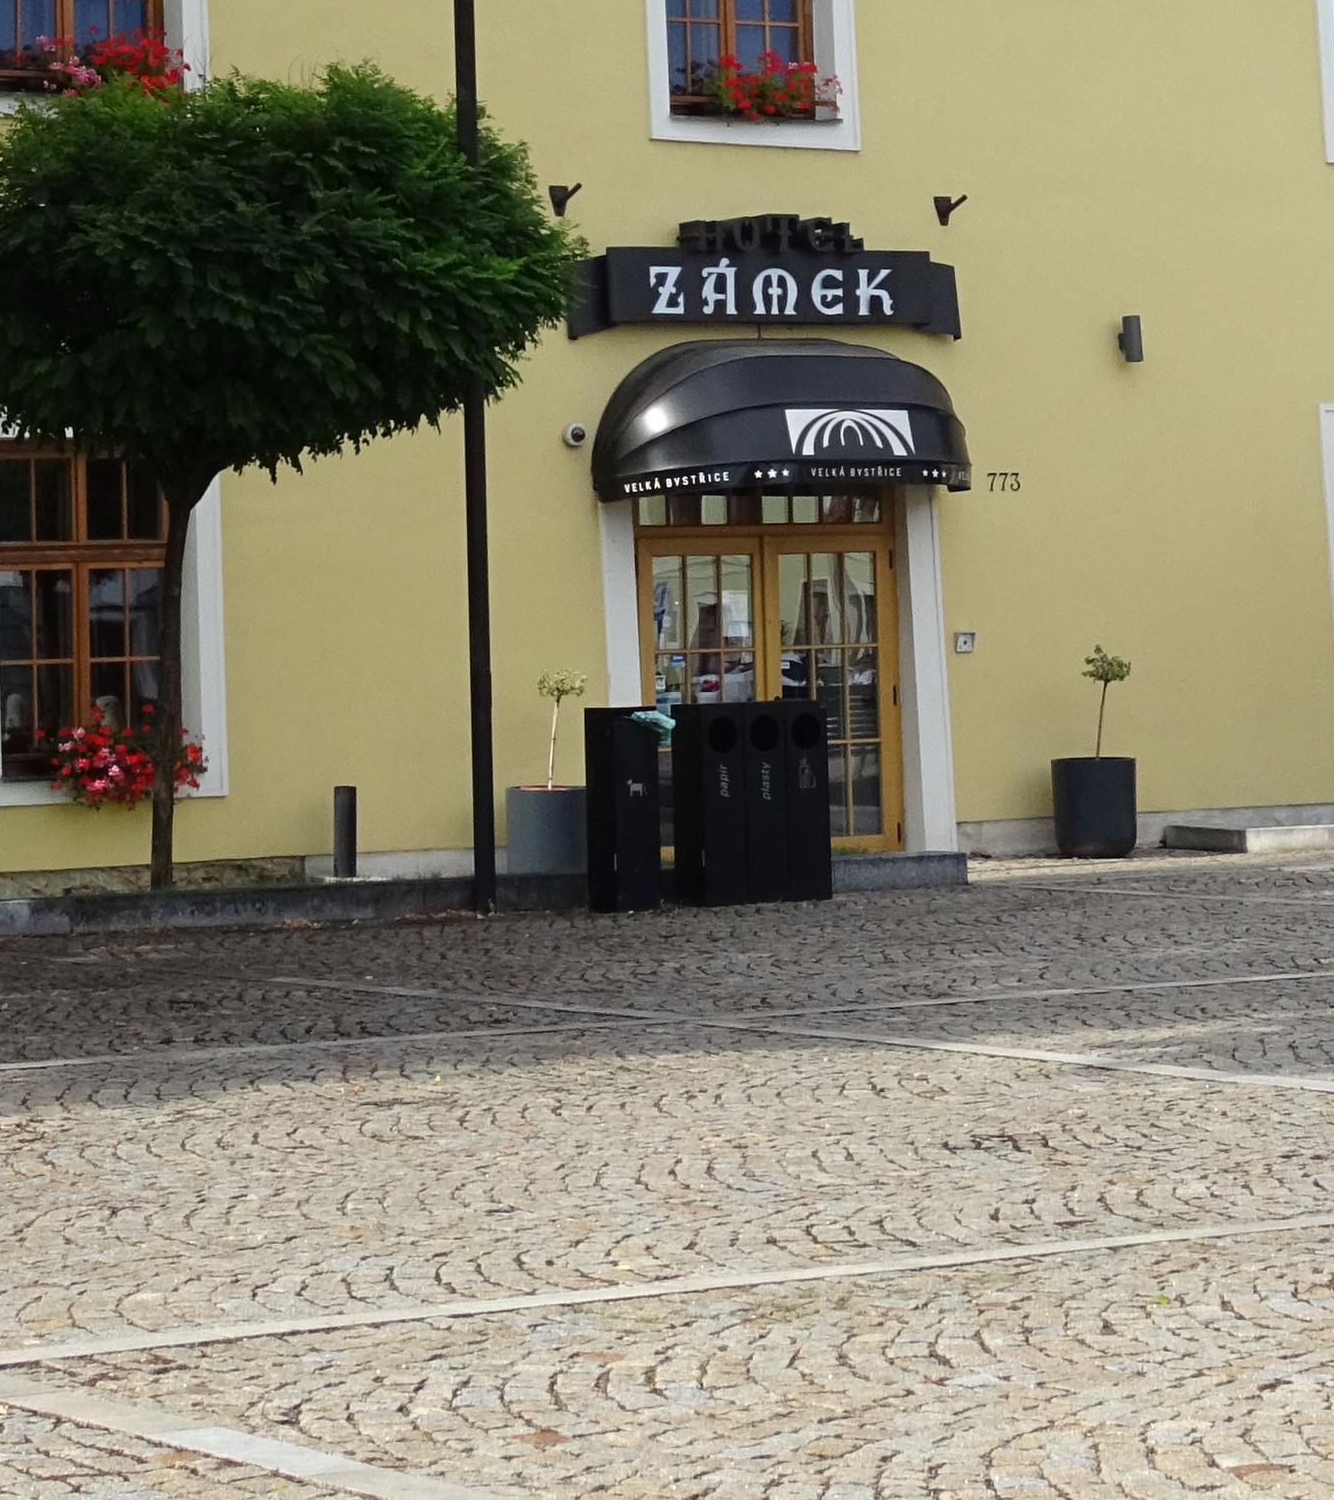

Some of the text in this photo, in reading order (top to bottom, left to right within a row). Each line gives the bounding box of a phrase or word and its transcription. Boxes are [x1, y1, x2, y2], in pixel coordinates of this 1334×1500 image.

[678, 214, 864, 253] HOTEL
[649, 257, 895, 316] ZÁMEK
[623, 471, 730, 494] VELKÁ BYSTŘICE
[810, 465, 903, 478] VELKÁ BYSTŘICE
[986, 472, 1022, 492] 773
[760, 761, 772, 800] plasty
